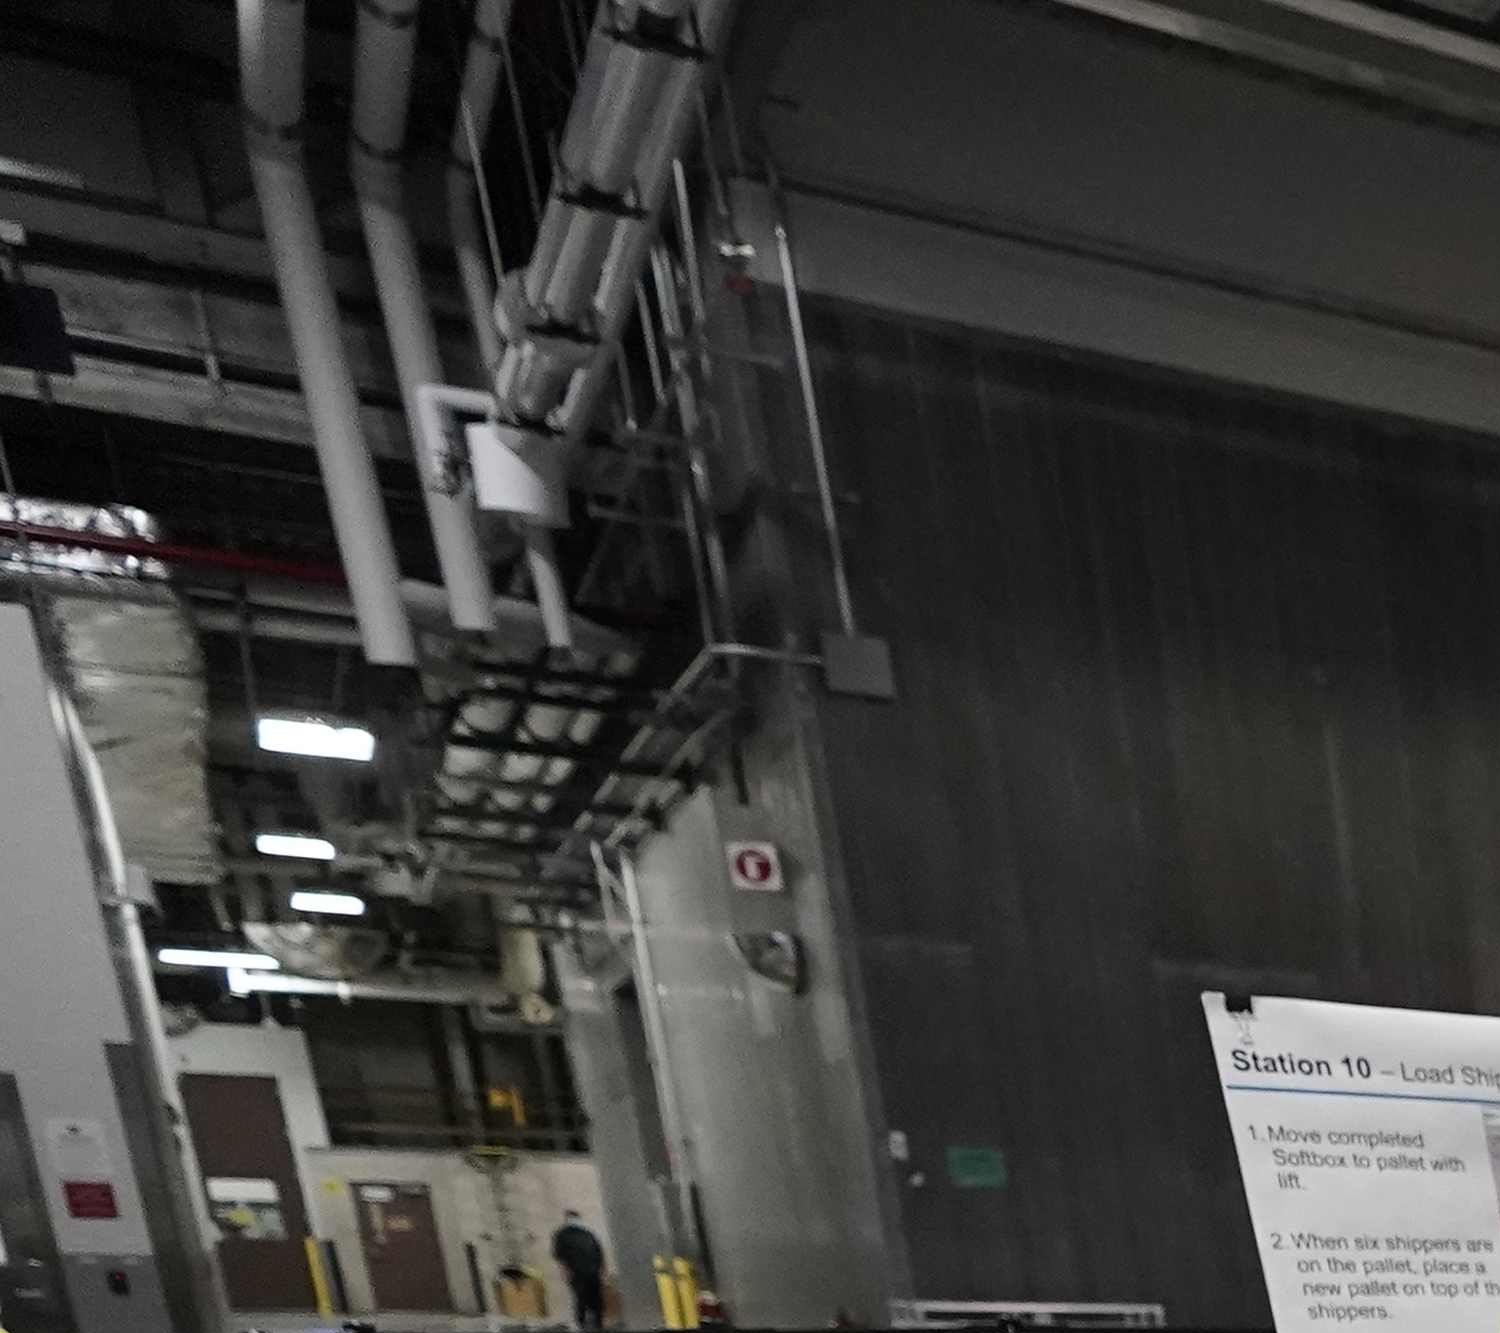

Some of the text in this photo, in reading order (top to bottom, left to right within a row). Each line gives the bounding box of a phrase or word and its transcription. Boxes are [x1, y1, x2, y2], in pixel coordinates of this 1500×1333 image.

[1231, 1049, 1332, 1078] Station
[1344, 1055, 1372, 1079] 10
[1400, 1063, 1454, 1085] Load
[1267, 1126, 1322, 1144] Move
[1327, 1131, 1425, 1150] completed
[1272, 1150, 1466, 1172] Softbox to pallet with
[1289, 1231, 1350, 1251] When
[1353, 1233, 1379, 1252] six
[1384, 1233, 1462, 1253] shippers
[1465, 1239, 1495, 1253] are
[1296, 1257, 1487, 1276] on the pallet, place a
[1301, 1283, 1342, 1297] new
[1348, 1281, 1398, 1298] pallet
[1401, 1282, 1425, 1296] on
[1429, 1282, 1459, 1298] top
[1462, 1281, 1480, 1296] of
[1306, 1302, 1393, 1323] shippers.
